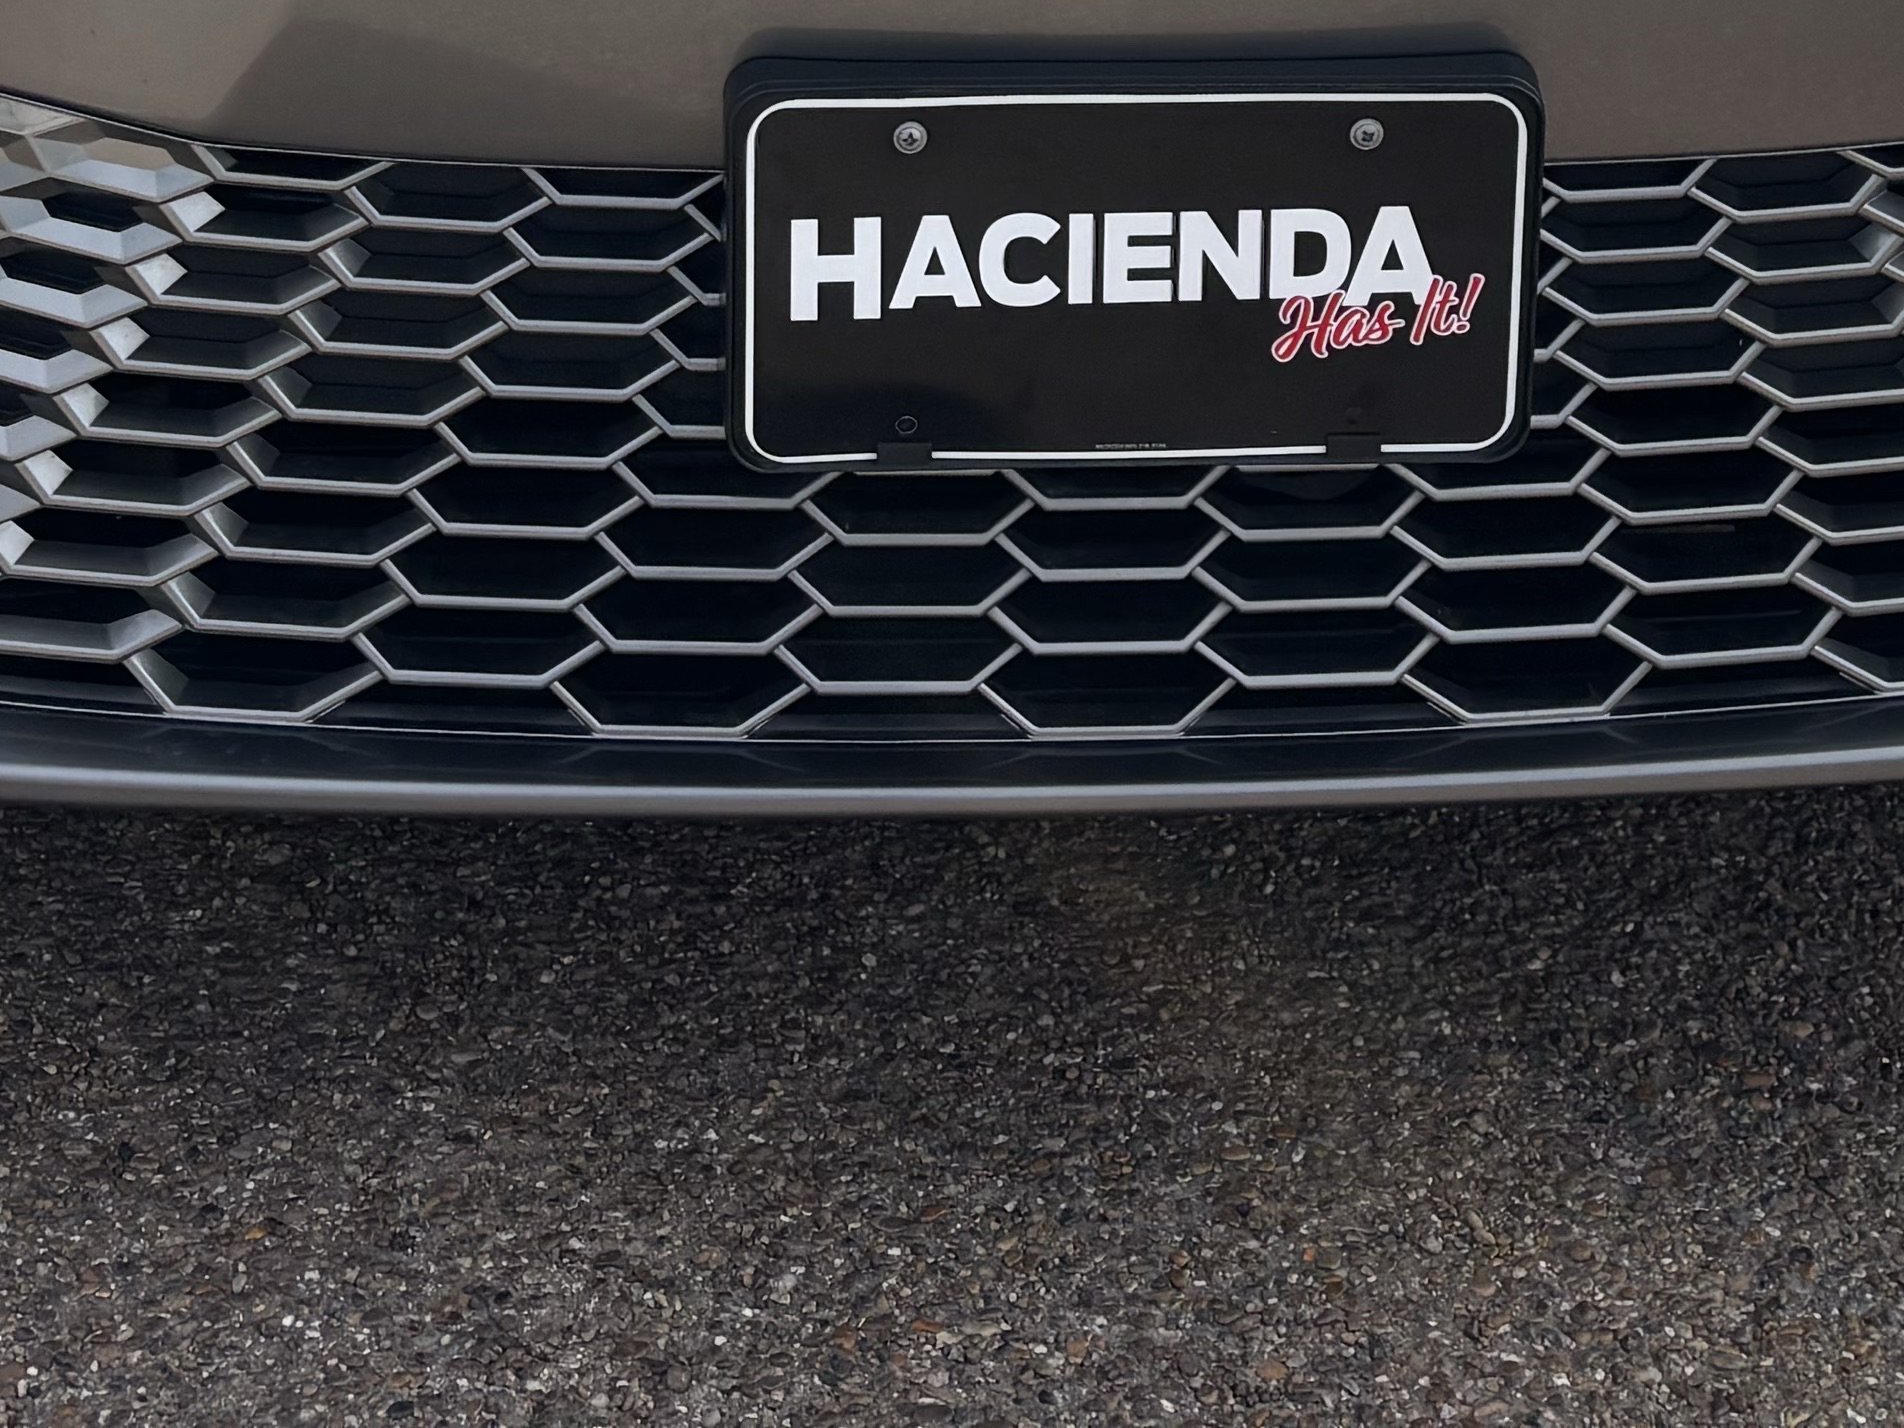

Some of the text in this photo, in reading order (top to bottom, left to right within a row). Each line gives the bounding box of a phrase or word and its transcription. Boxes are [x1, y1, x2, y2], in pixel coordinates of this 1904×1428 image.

[789, 204, 1437, 322] HACIENDA
[1271, 273, 1486, 363] Has It!
